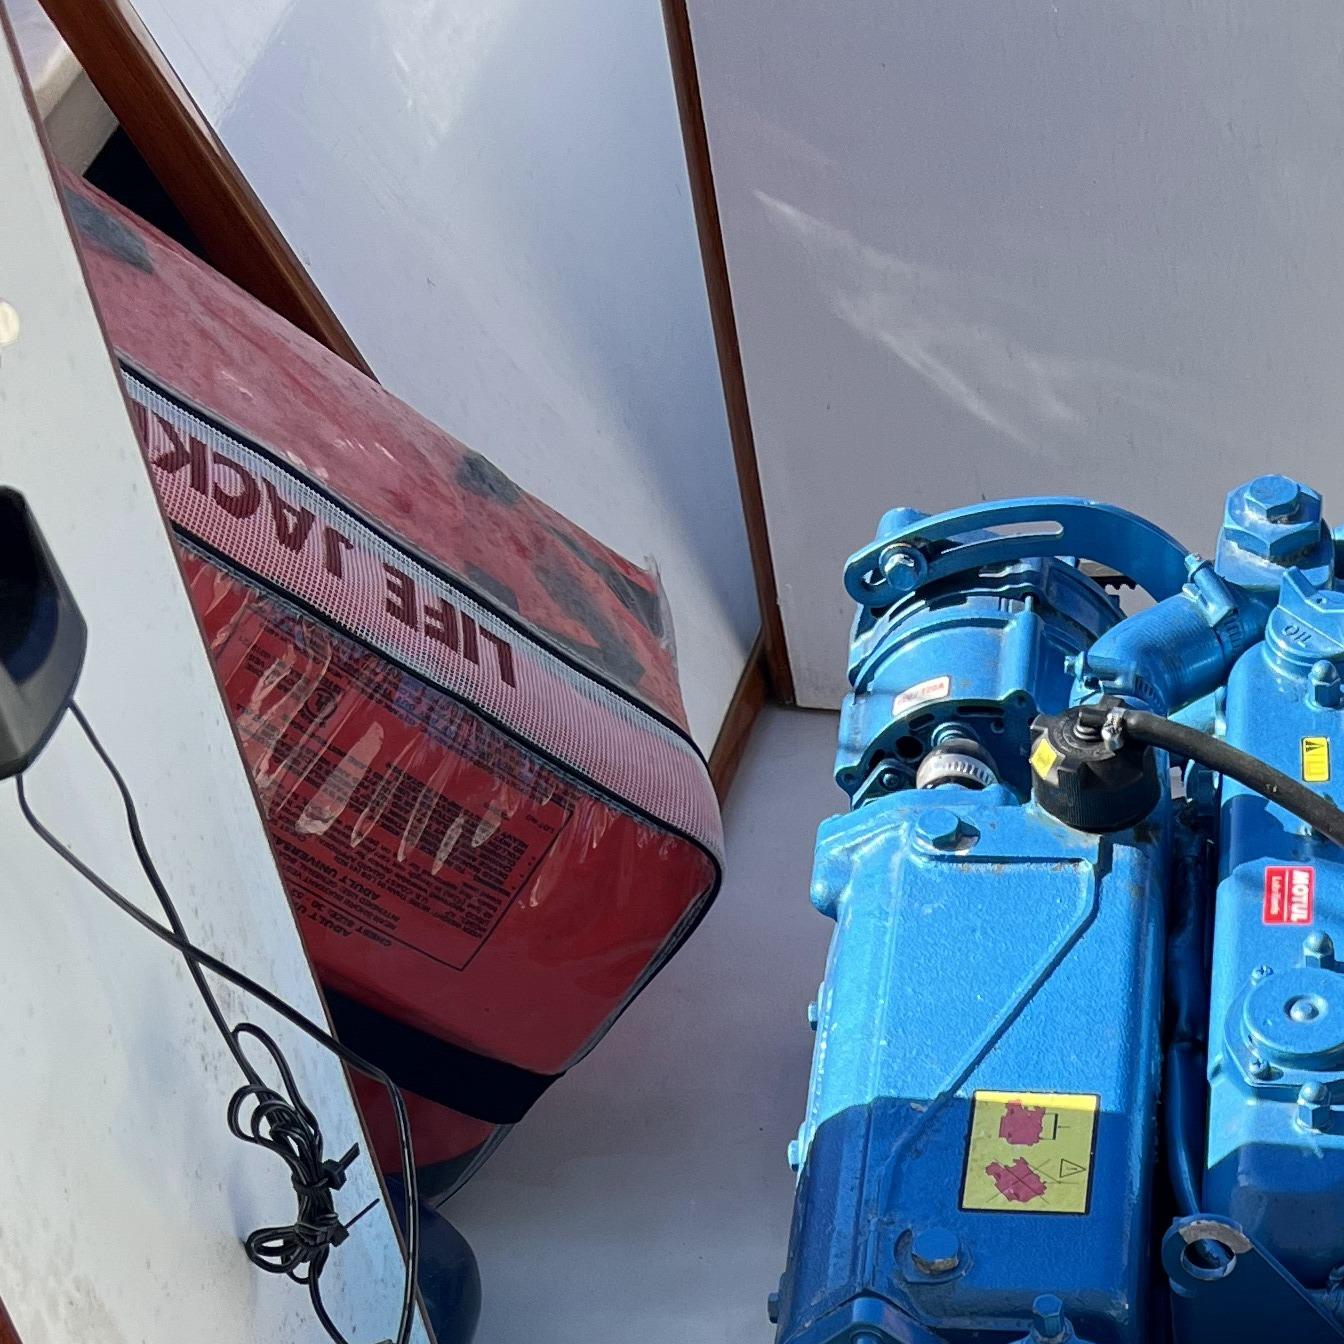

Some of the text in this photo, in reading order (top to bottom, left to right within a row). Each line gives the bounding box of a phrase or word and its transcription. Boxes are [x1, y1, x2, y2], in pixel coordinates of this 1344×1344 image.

[383, 562, 516, 688] LIFE
[1281, 623, 1312, 648] OIL
[1290, 870, 1309, 922] MOTUL
